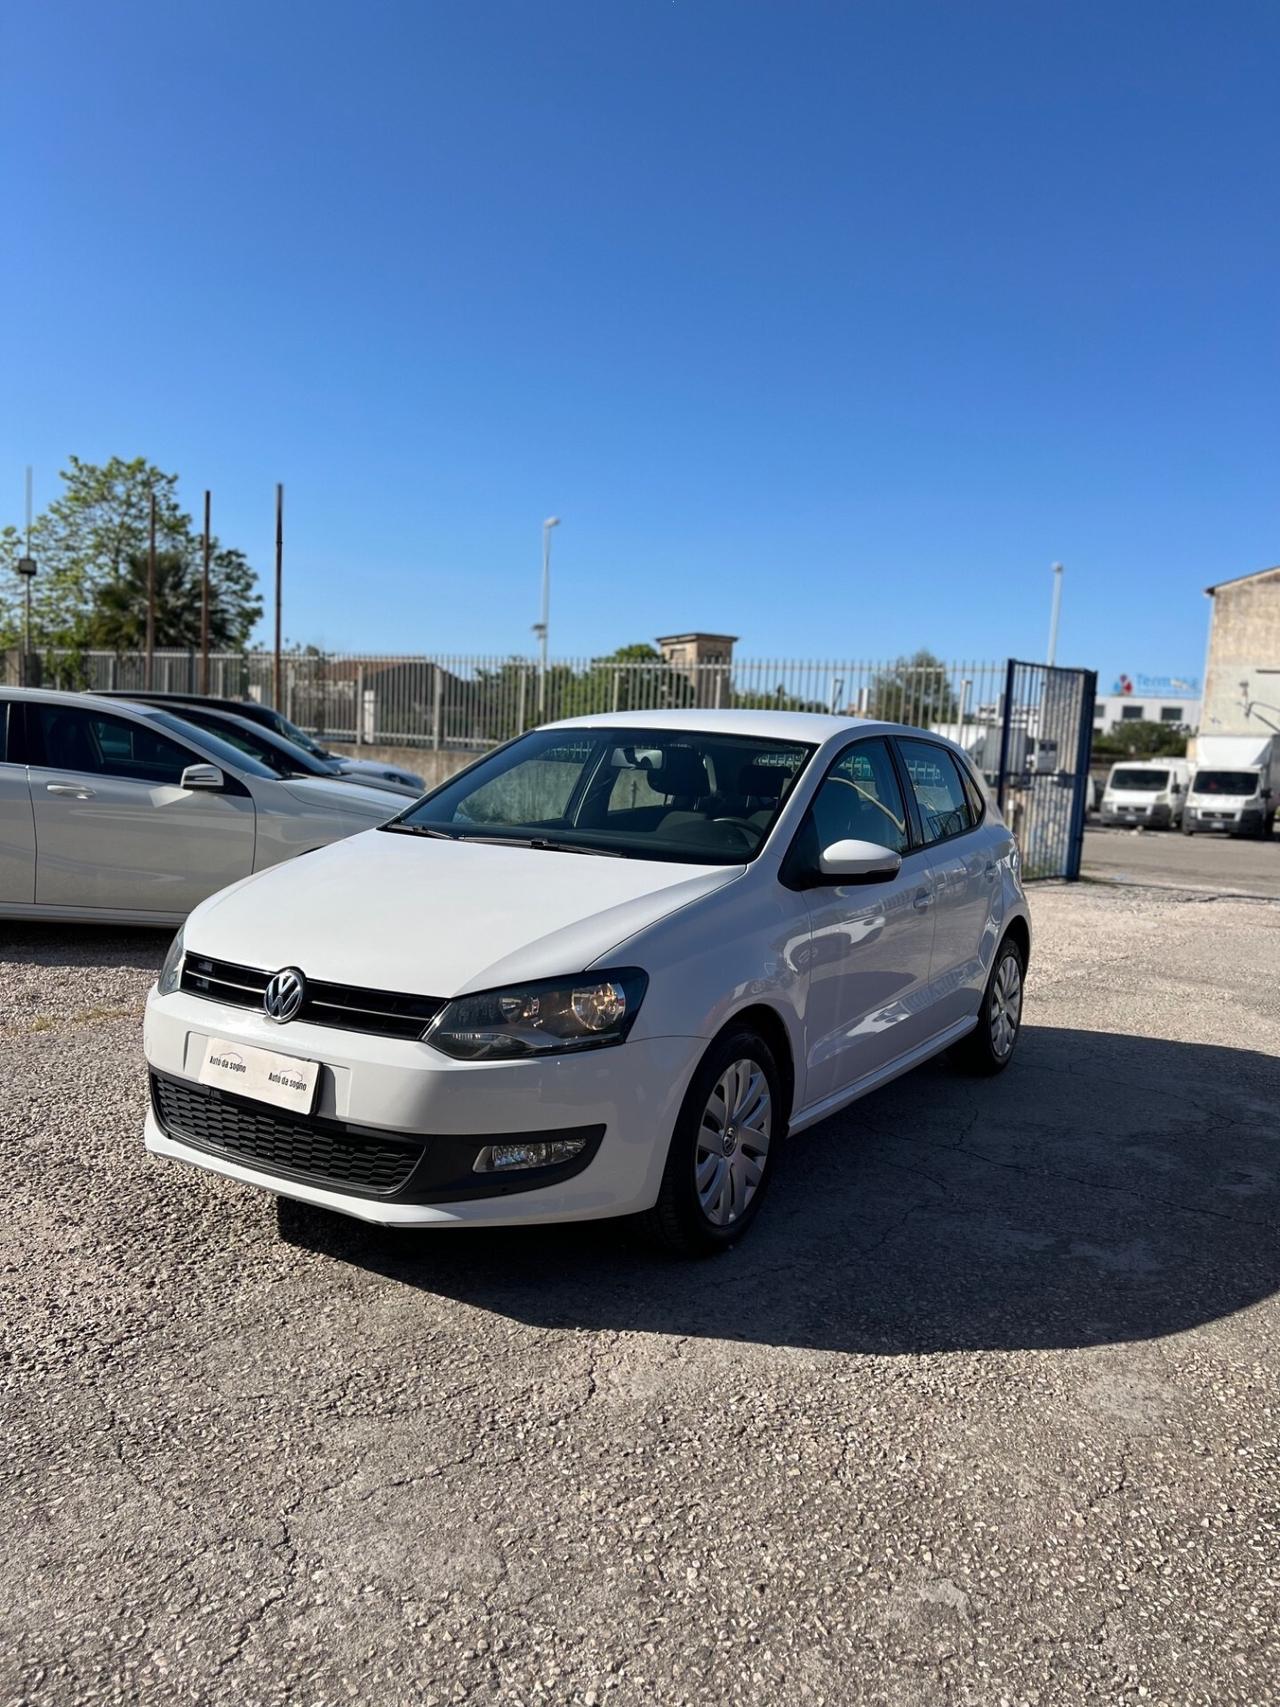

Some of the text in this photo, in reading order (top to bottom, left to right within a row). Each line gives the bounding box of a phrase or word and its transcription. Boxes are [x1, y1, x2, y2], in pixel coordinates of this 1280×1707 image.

[266, 971, 301, 1020] VW
[209, 1055, 247, 1073] Auto da sogno
[268, 1072, 307, 1092] Auto da sogno
